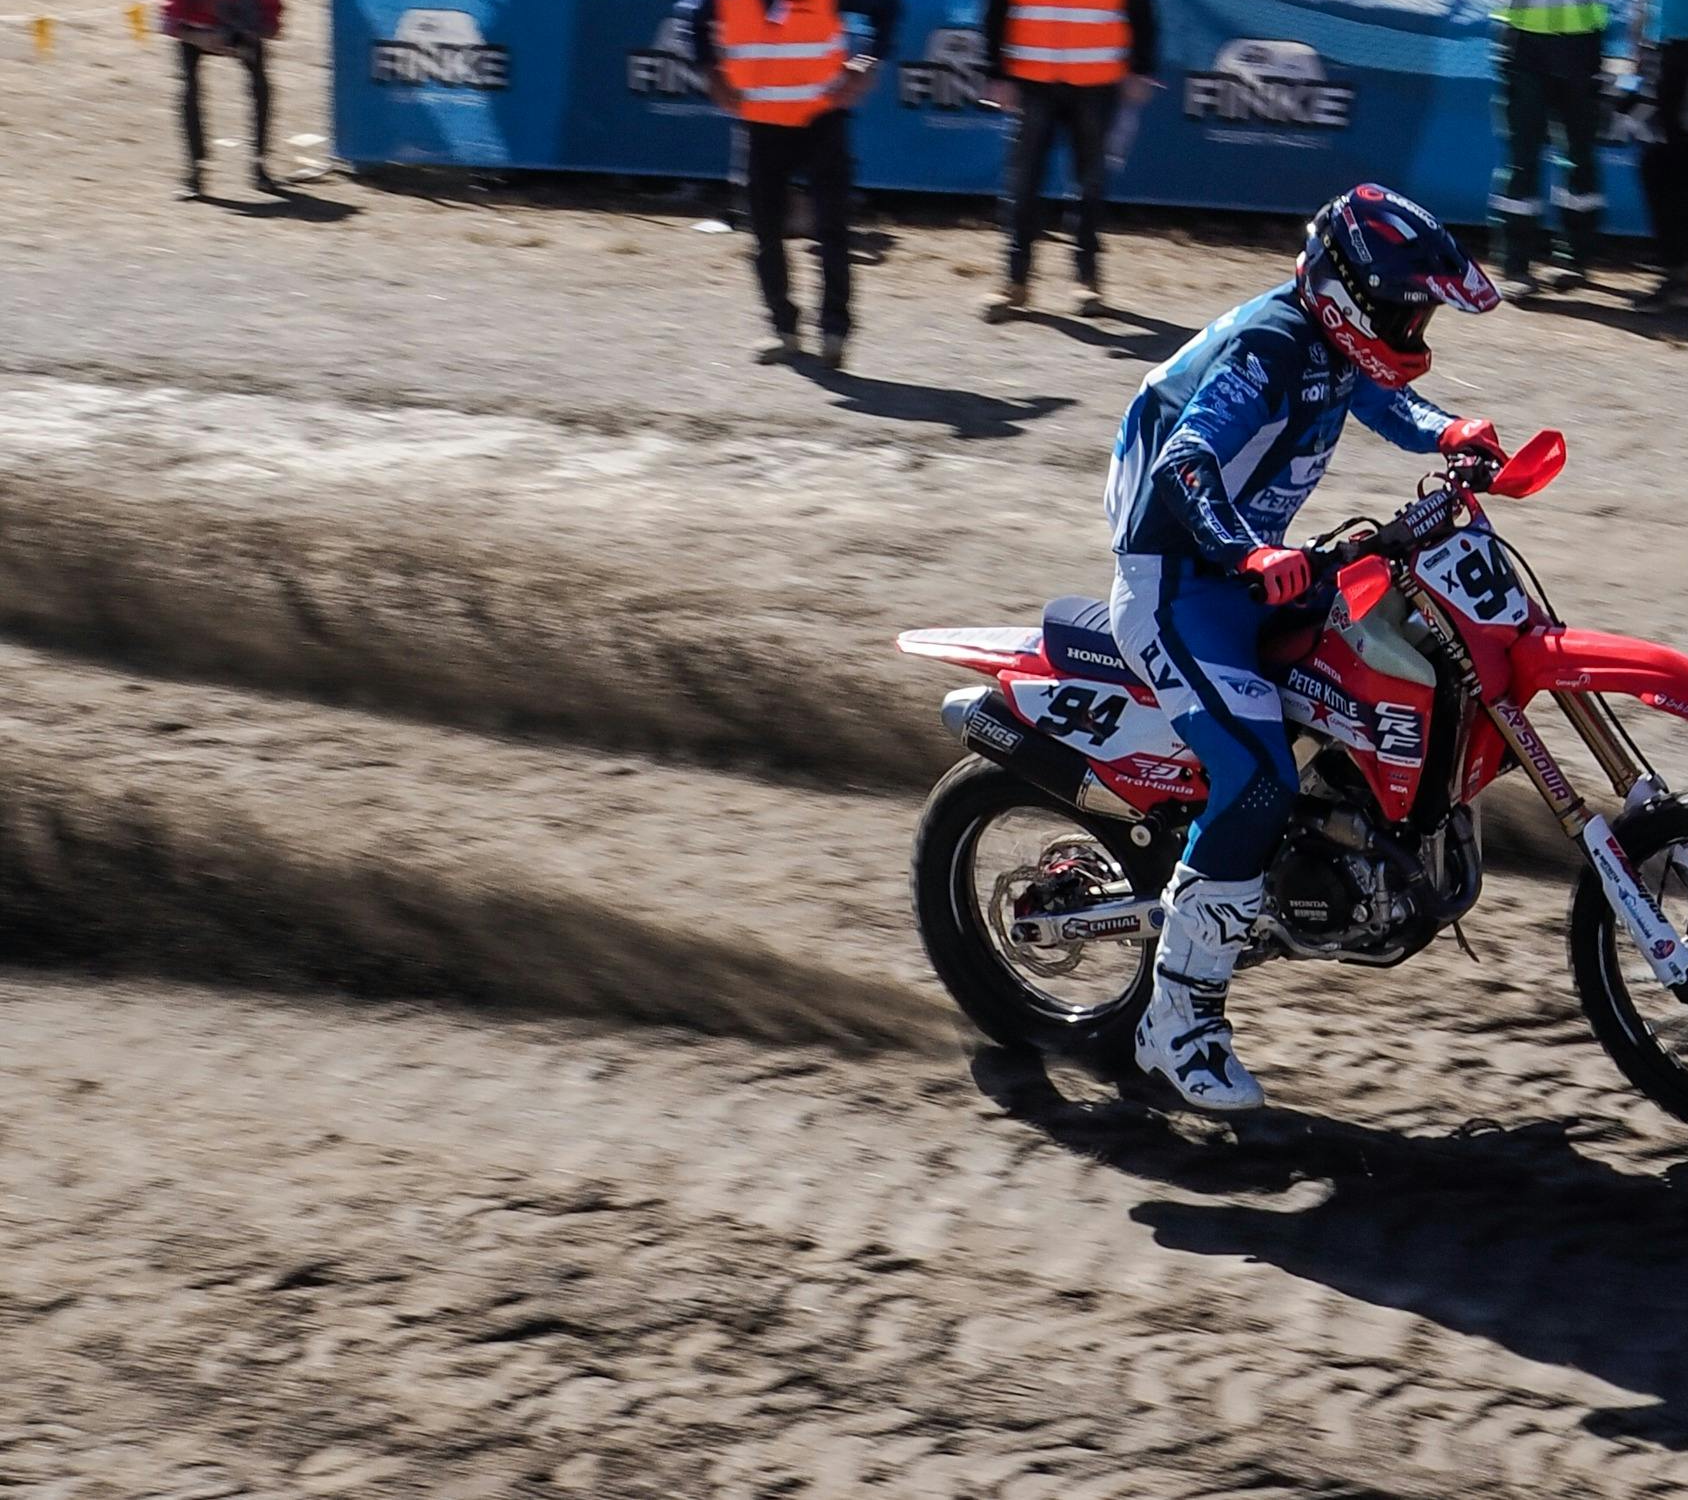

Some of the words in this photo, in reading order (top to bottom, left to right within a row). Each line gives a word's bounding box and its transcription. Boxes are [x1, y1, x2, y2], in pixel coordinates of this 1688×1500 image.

[627, 53, 712, 93] FIN
[903, 65, 988, 108] FIN
[1185, 75, 1353, 127] FINKE
[1323, 234, 1376, 313] OAKLEY
[1067, 647, 1126, 670] HONDA
[1314, 658, 1343, 684] HONDA
[1288, 668, 1322, 700] PETER
[1323, 683, 1359, 719] KITTLE
[1374, 701, 1422, 750] CRF
[1516, 730, 1571, 801] SHOWA
